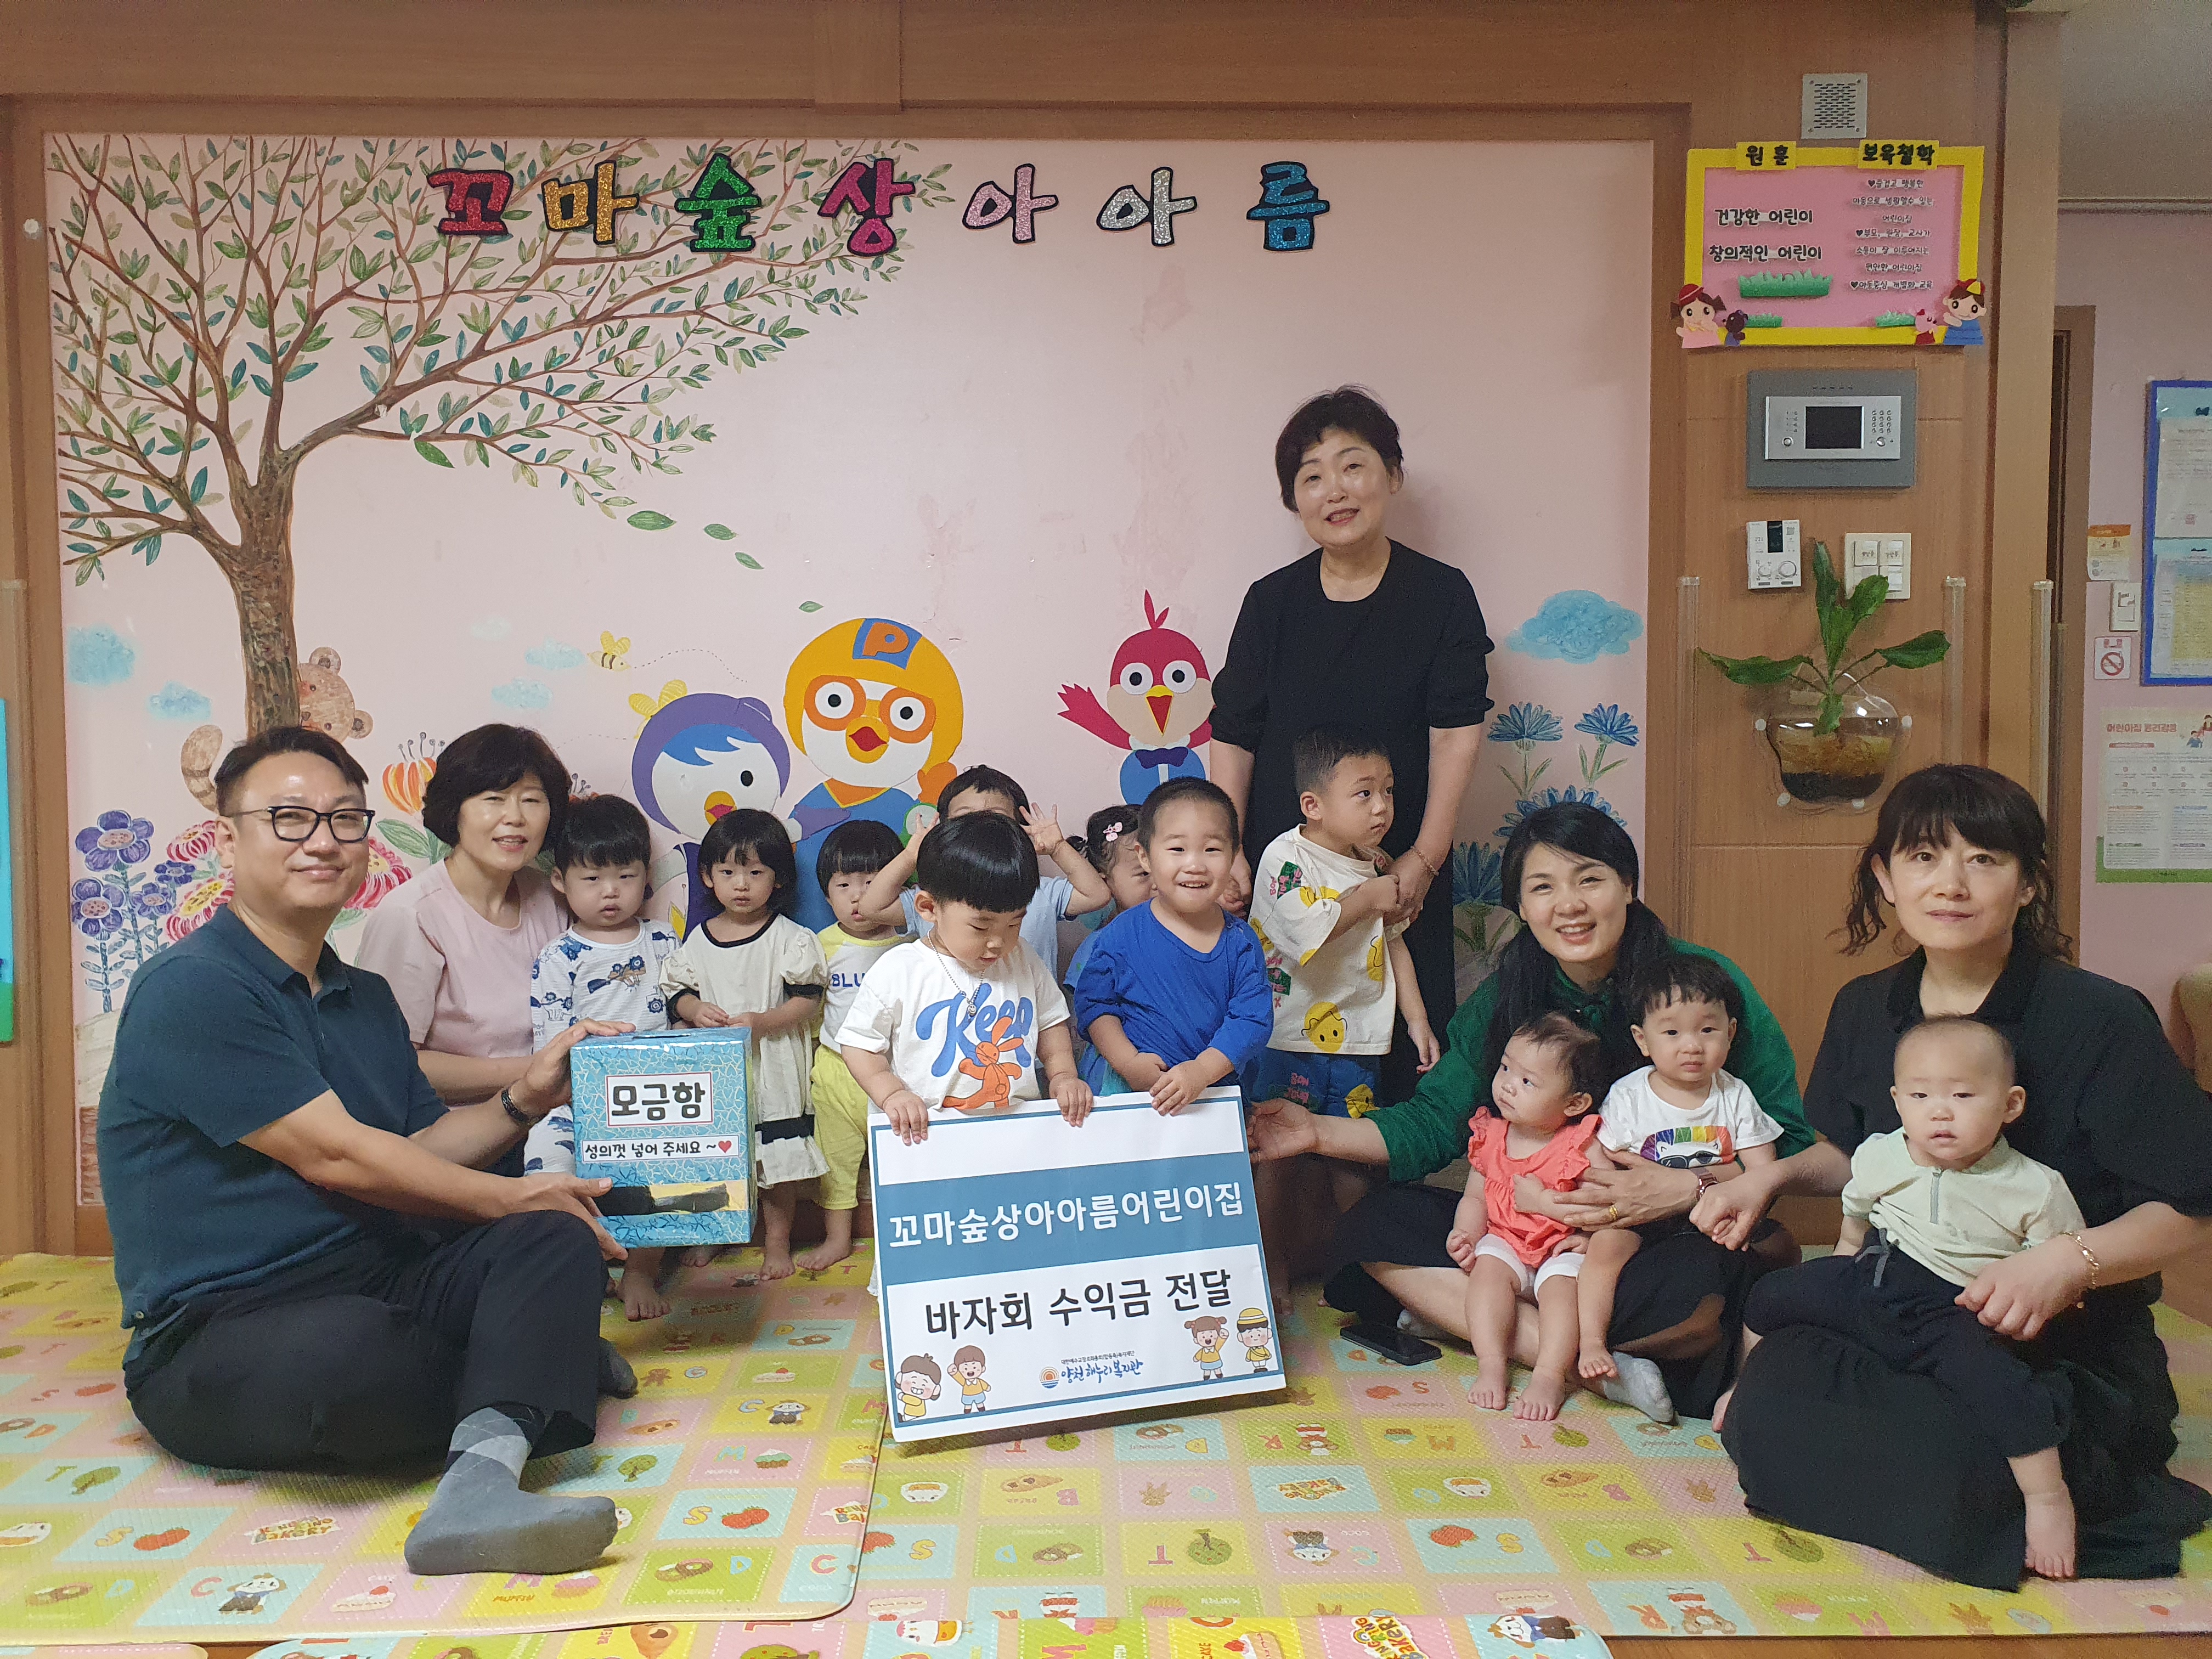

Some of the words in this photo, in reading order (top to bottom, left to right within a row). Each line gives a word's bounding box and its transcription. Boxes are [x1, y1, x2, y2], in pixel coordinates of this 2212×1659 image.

[1862, 143, 1935, 165] 보육철학
[1715, 208, 1760, 225] 건강한
[1768, 209, 1813, 224] 어린이
[1882, 215, 1912, 223] 어린이집
[1708, 245, 1768, 263] 창의적인
[1778, 245, 1822, 262] 어린이
[1894, 246, 1929, 255] 이루어지는
[1866, 263, 1888, 272] 편안한
[1893, 263, 1922, 272] 어린이집
[1920, 280, 1933, 289] 교육
[916, 983, 1033, 1077] Keep
[611, 1082, 706, 1121] 모금함
[585, 1142, 626, 1159] 성의껏
[631, 1142, 658, 1159] 넣어
[663, 1141, 701, 1158] 주세요
[888, 1182, 1244, 1248] 꼬마숲상아아름어린이집
[925, 1292, 1033, 1340] 바자회
[1048, 1279, 1151, 1327] 수익금
[1166, 1269, 1231, 1313] 전달
[683, 1505, 713, 1525] S
[909, 1538, 936, 1560] S
[1496, 1532, 1525, 1554] S
[810, 1554, 838, 1575] C
[1148, 1544, 1173, 1565] T
[730, 1555, 752, 1575] D
